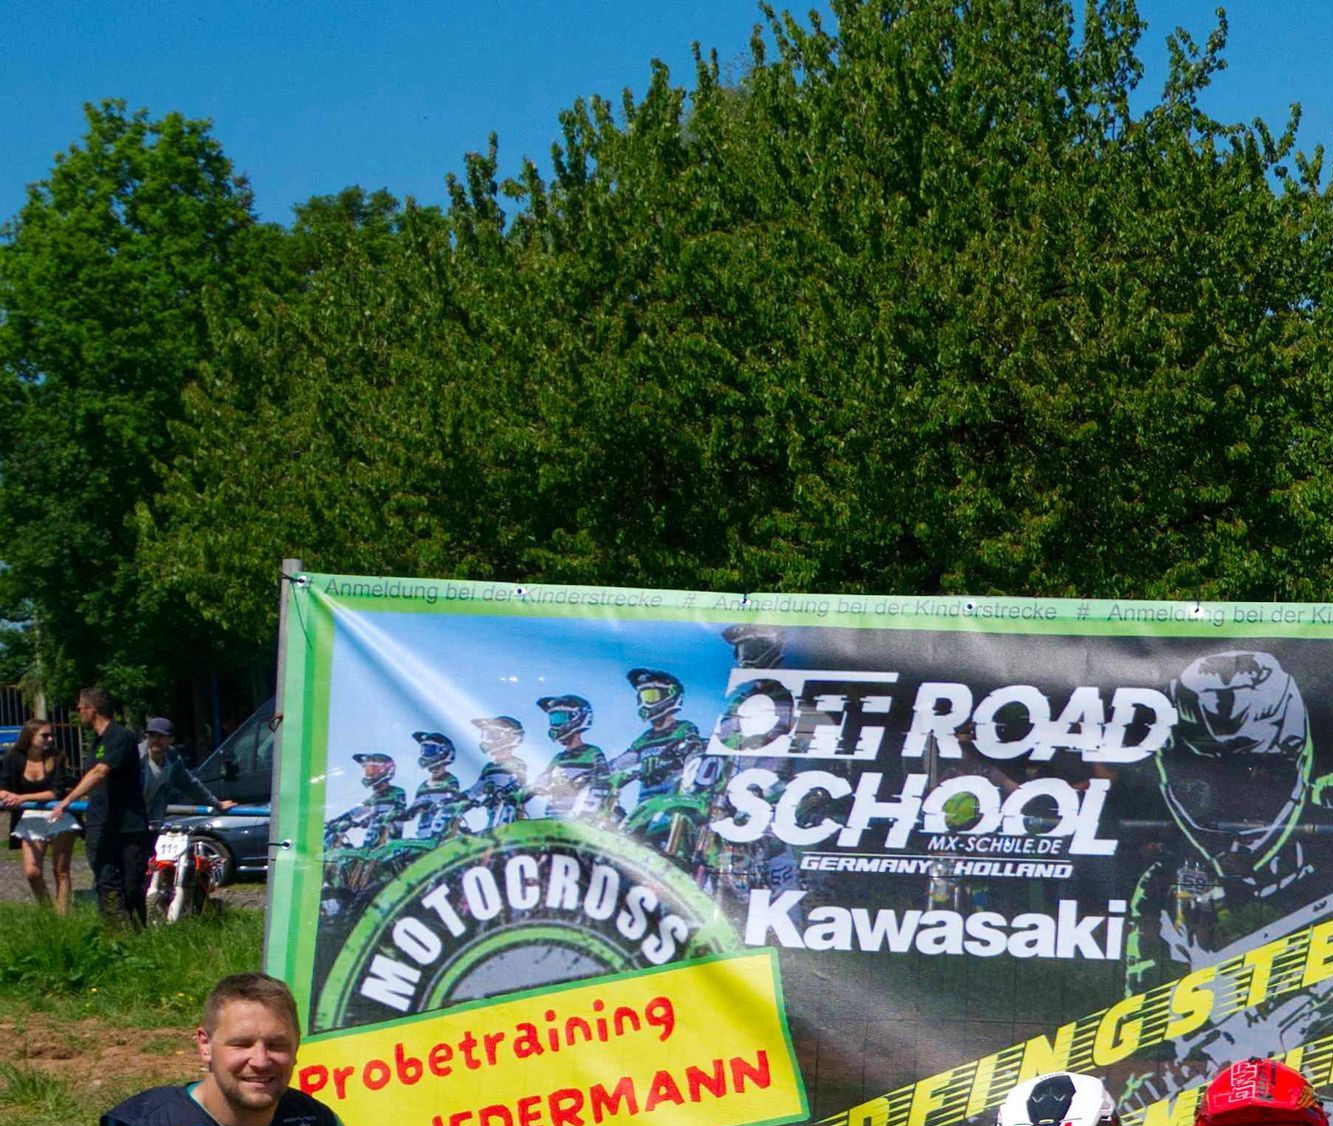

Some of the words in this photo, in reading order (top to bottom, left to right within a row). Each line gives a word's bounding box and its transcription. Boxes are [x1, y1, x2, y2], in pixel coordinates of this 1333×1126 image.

[324, 578, 438, 603] Anmeldung
[446, 583, 474, 601] bei
[482, 585, 516, 603] der
[524, 586, 663, 609] Kinderstrecke
[837, 596, 868, 615] bei
[875, 597, 906, 616] der
[1076, 604, 1090, 620] #
[1233, 604, 1263, 624] bei
[1271, 605, 1303, 624] der
[904, 682, 1178, 766] ROAD
[710, 768, 1119, 857] SCHOOL
[926, 834, 1062, 856] MX-SCHULE.DE
[801, 855, 933, 876] GERMANY
[953, 860, 1074, 880] HOLLAND
[361, 852, 689, 1013] MOTOCROSS
[745, 888, 1127, 962] Kawasaki
[298, 995, 676, 1100] Probetraining
